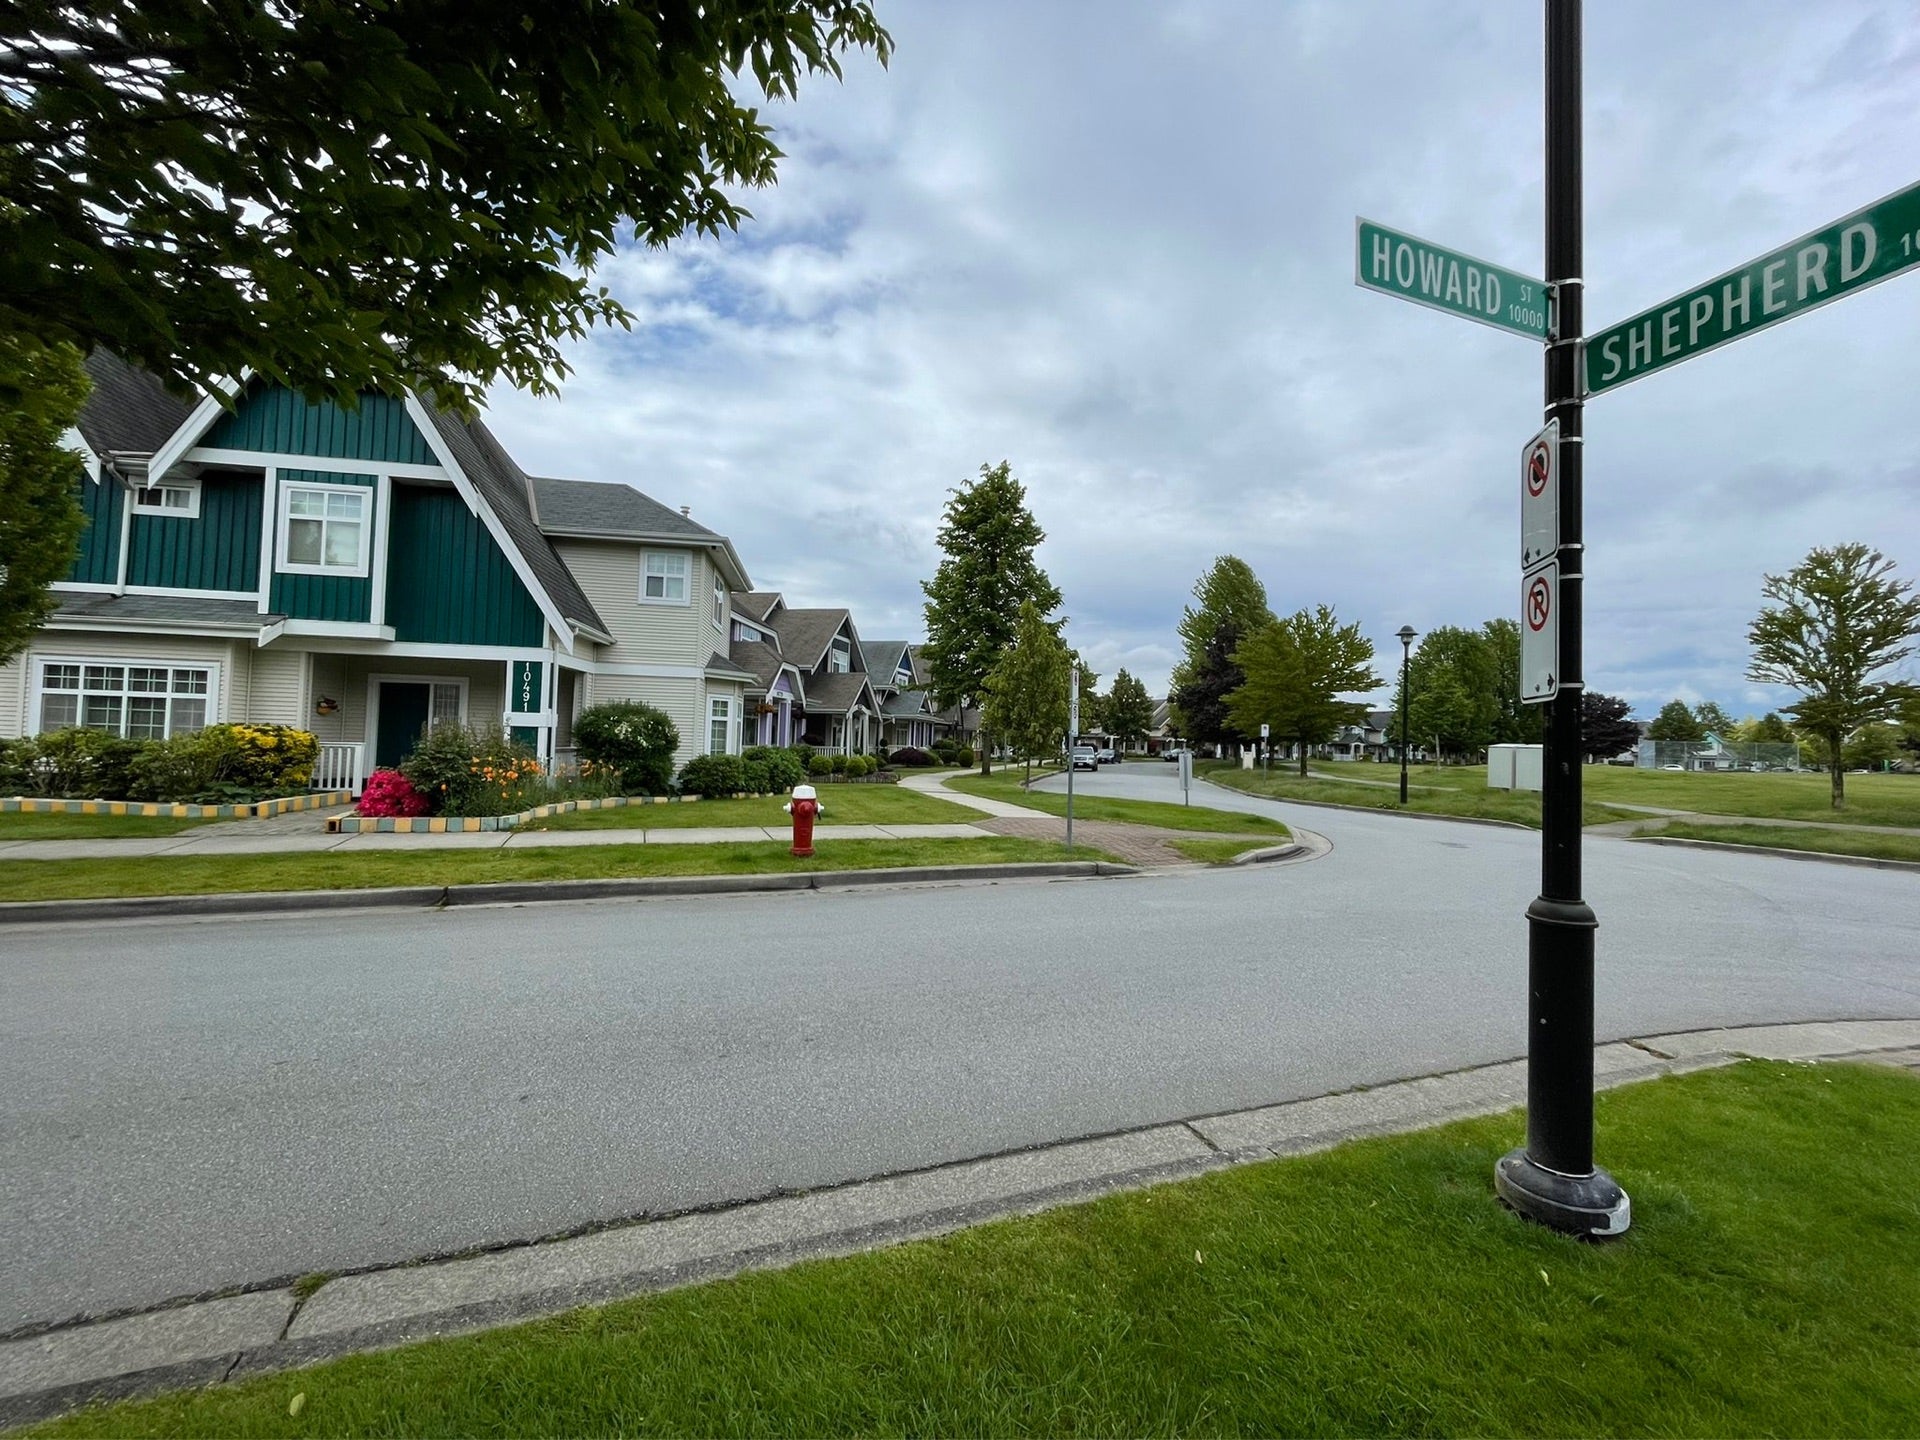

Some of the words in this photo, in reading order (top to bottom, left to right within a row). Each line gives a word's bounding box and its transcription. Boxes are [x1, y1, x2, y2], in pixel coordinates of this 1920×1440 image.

[1372, 233, 1501, 316] HOWARD
[1520, 284, 1531, 303] ST
[1509, 303, 1543, 329] 10000
[1601, 222, 1877, 381] SHEPHERD
[522, 662, 532, 712] 10491
